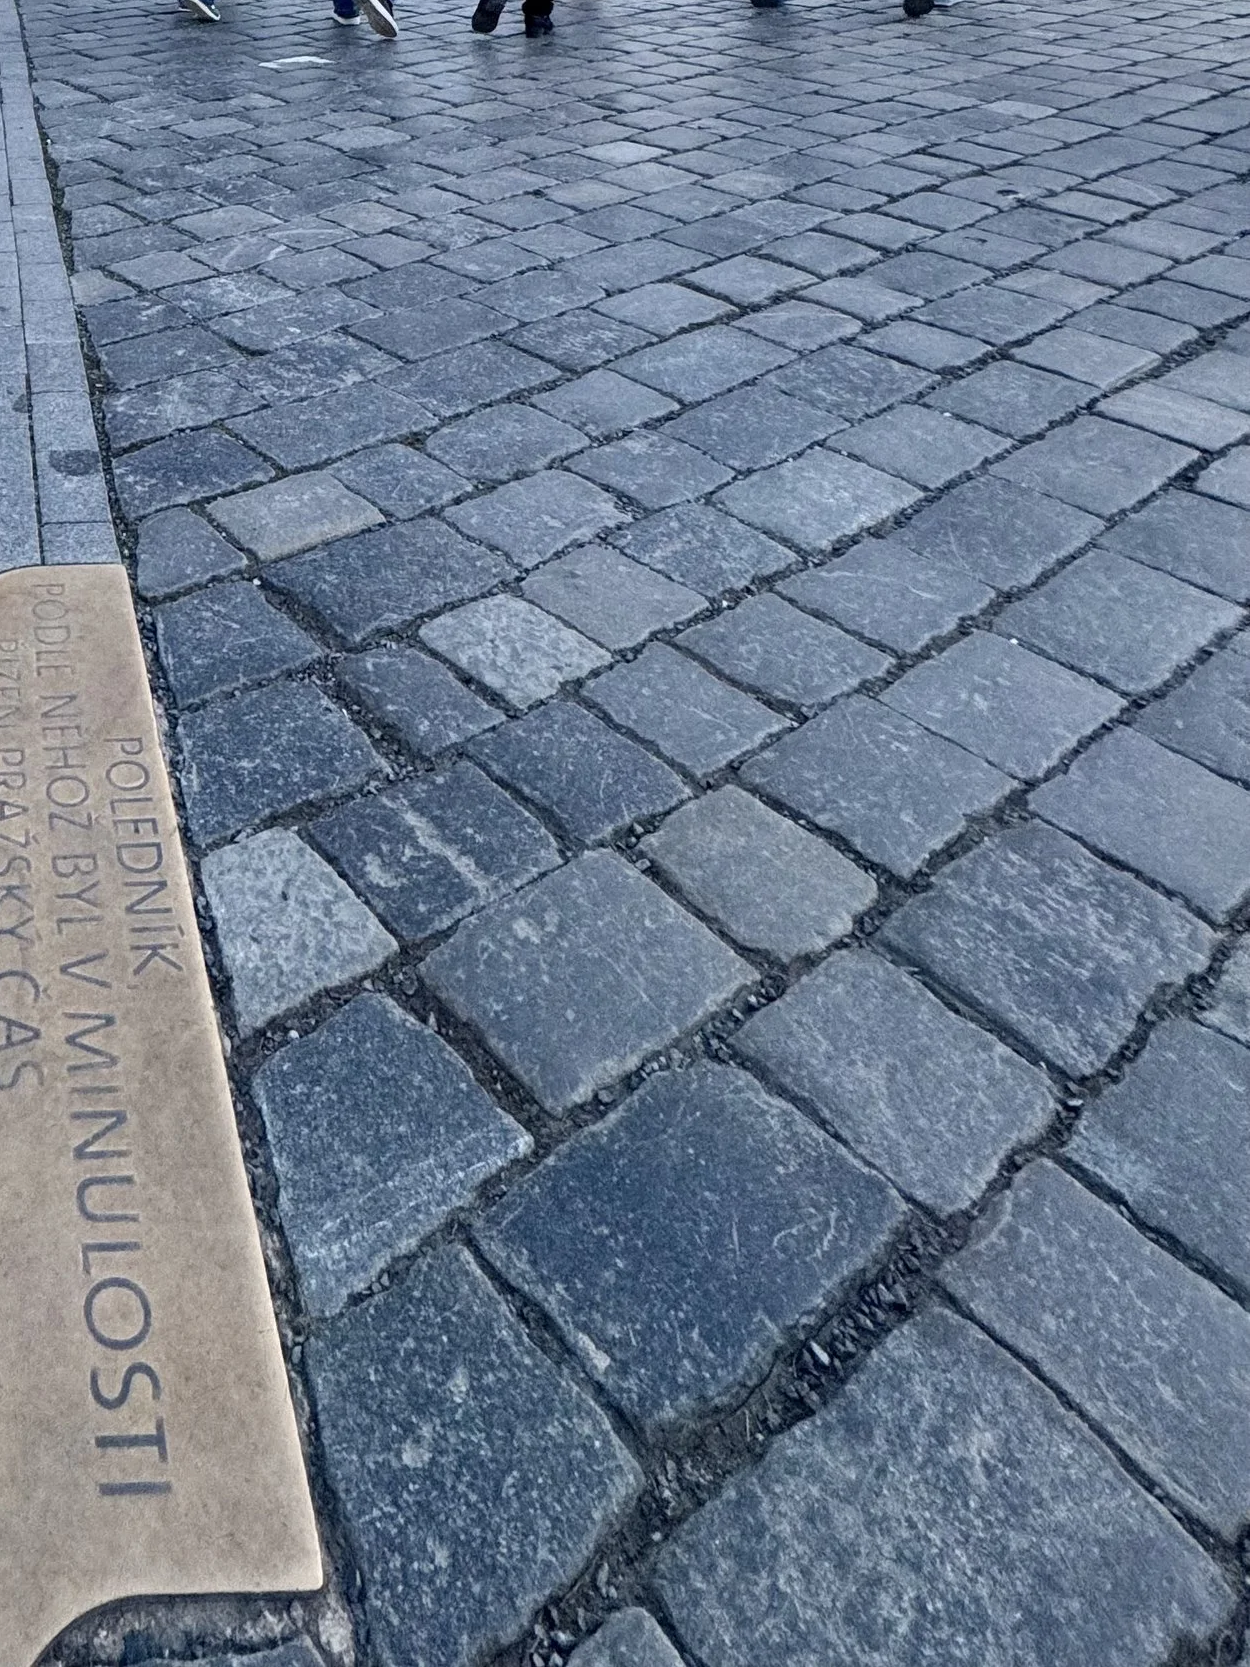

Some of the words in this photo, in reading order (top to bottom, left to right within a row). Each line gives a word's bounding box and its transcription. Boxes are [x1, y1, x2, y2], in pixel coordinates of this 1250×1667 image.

[31, 582, 77, 677] PODLE
[40, 692, 102, 832] NĚHOŽ
[51, 852, 104, 935] BYL
[59, 950, 112, 989] V
[60, 1011, 172, 1497] MINULOSTI
